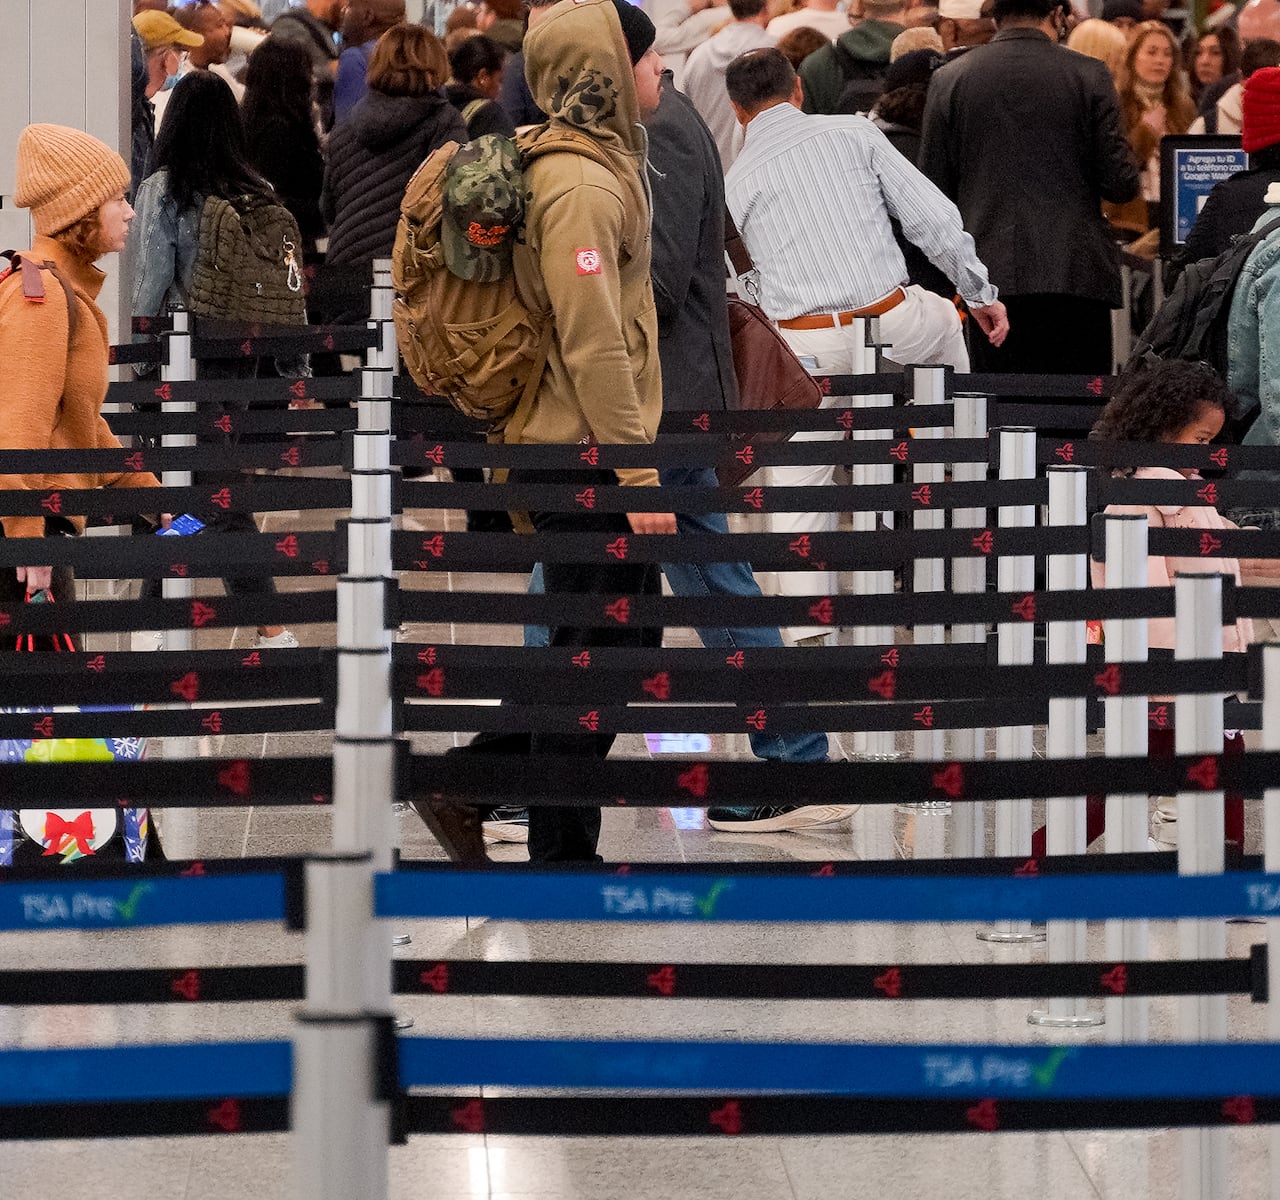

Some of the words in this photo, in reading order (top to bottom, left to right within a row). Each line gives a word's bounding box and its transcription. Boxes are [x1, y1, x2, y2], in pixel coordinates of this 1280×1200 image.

[24, 895, 68, 922] TSA
[72, 894, 116, 920] Pre
[602, 887, 648, 915] TSA
[653, 888, 695, 914] Pre
[925, 1056, 975, 1085] TSA
[981, 1056, 1031, 1085] Pre
